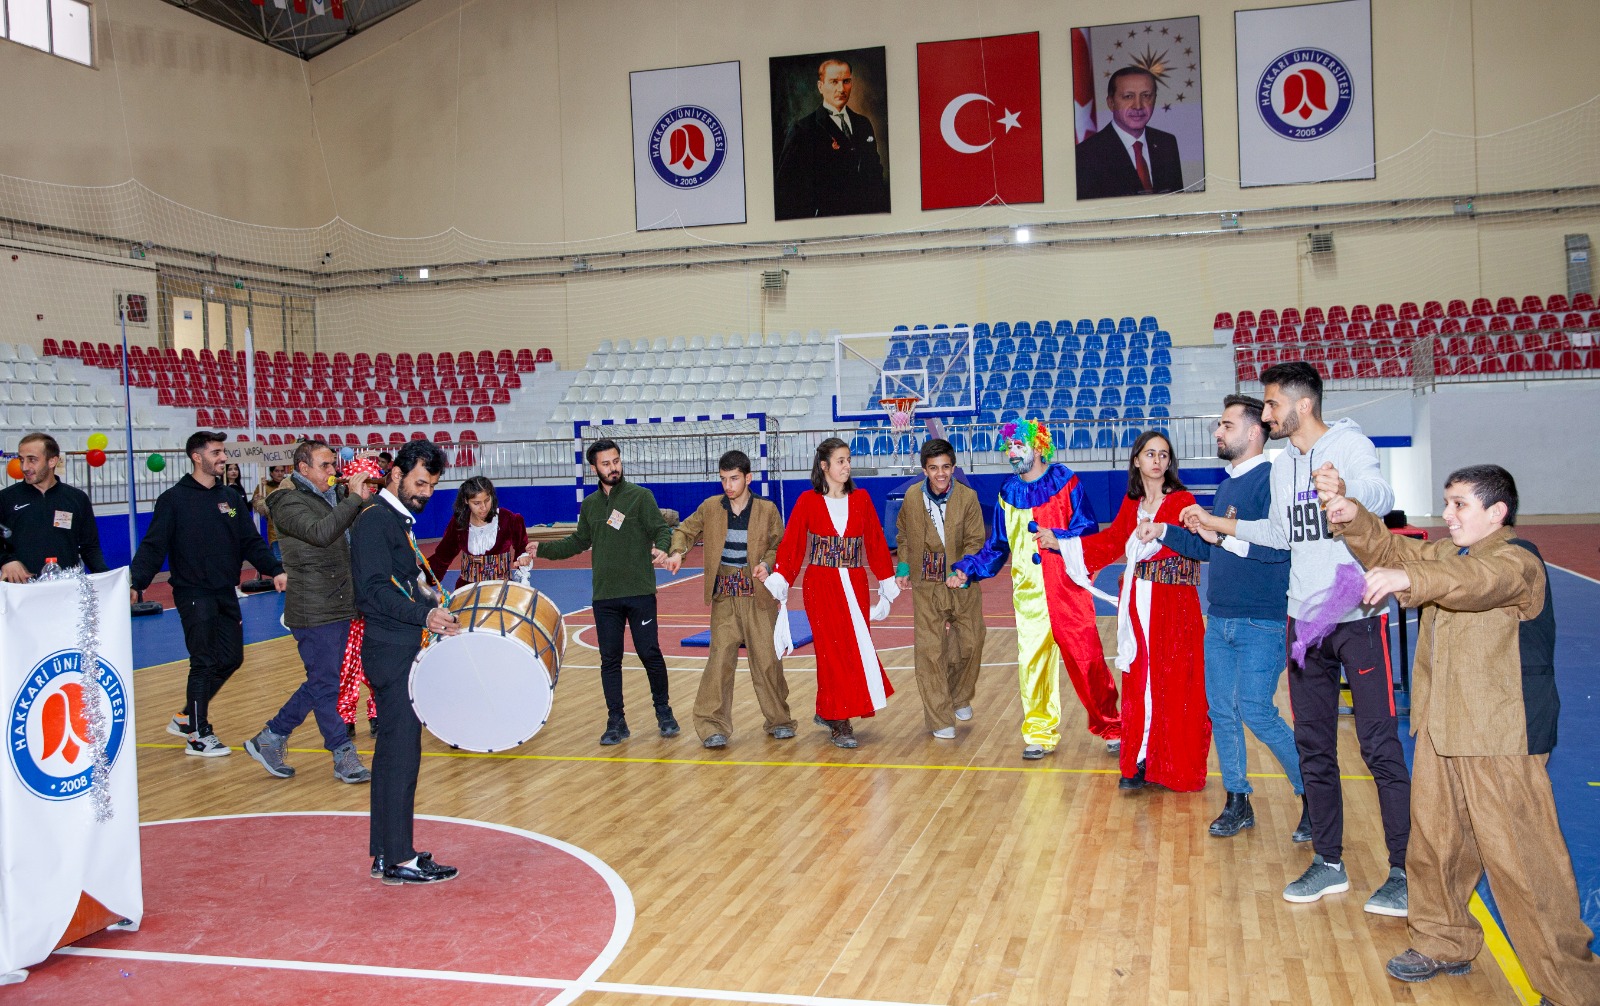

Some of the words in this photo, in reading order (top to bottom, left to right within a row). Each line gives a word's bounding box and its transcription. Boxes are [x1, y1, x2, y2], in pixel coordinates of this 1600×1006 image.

[1262, 57, 1289, 106] HAKKARİ
[1293, 50, 1351, 99] ÜNİVERSİTESİ
[652, 113, 675, 158] HAKKARİ
[677, 108, 725, 151] ÜNİVERSİTESİ
[1295, 128, 1317, 137] 2008
[680, 177, 698, 186] 2008
[244, 446, 264, 457] VARSA
[263, 451, 283, 462] NGEL
[14, 666, 50, 751] HAKKARİ
[53, 654, 125, 723] ÜNİRSİTESİ
[59, 775, 88, 793] 2008
